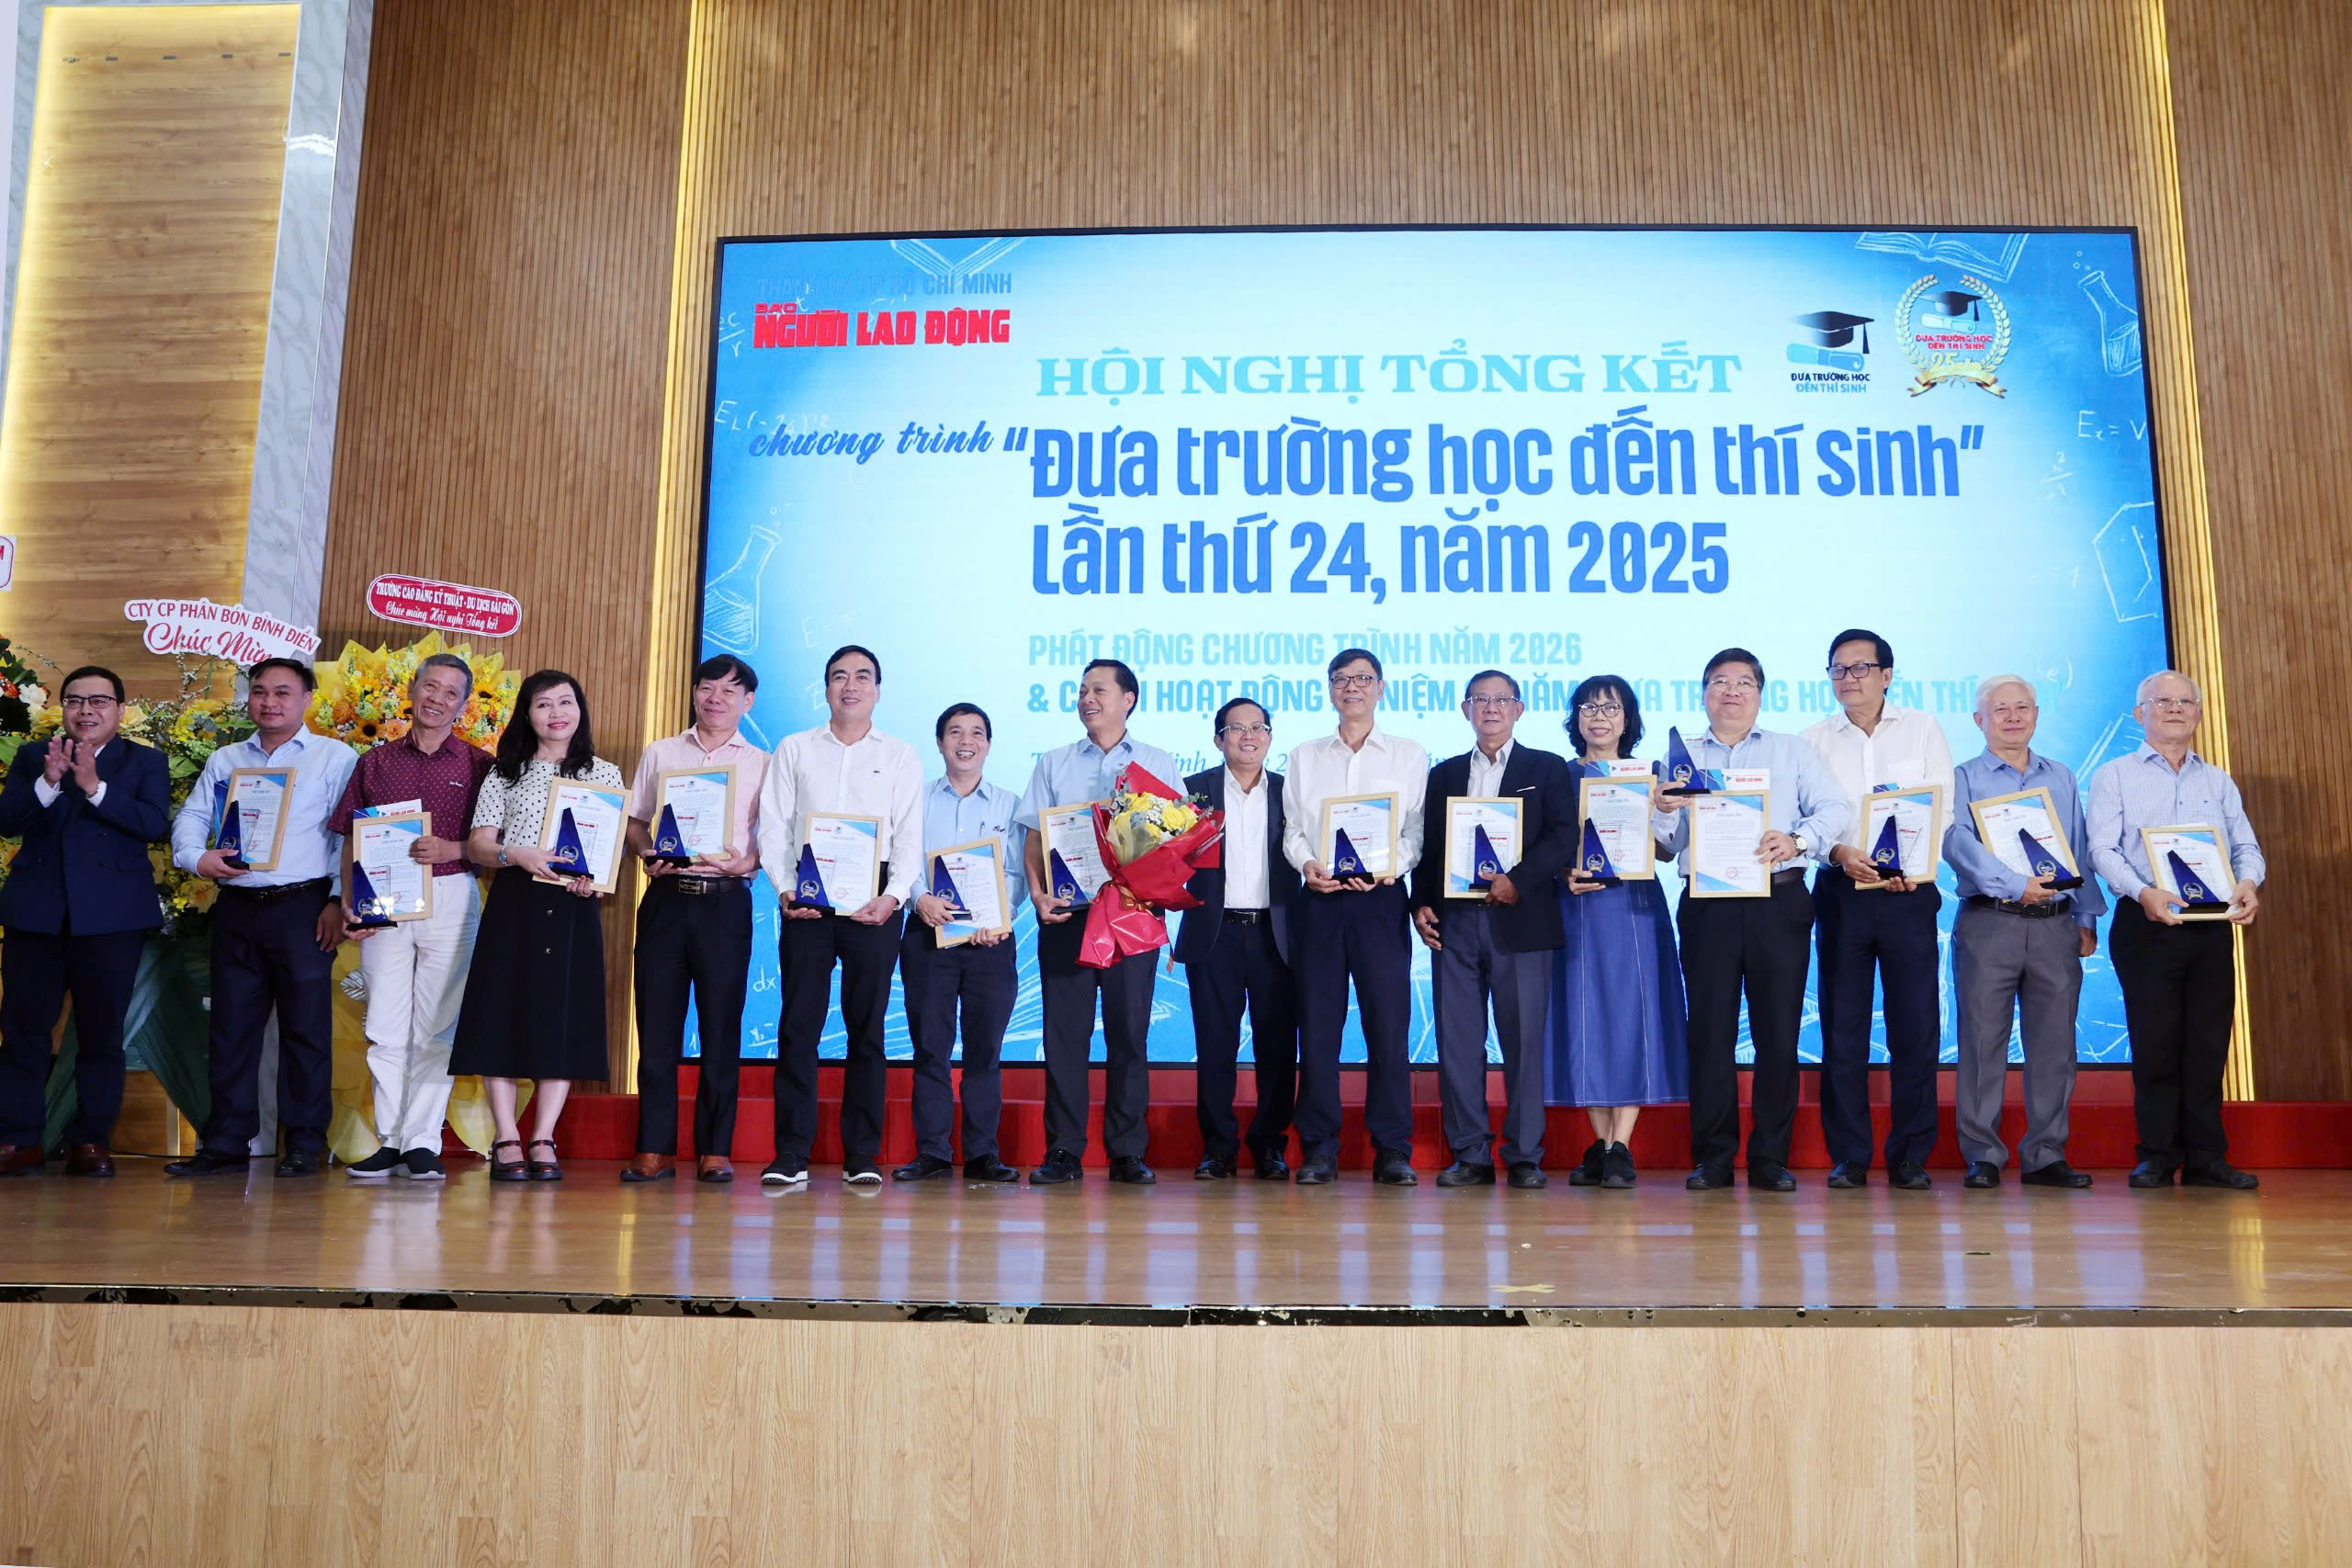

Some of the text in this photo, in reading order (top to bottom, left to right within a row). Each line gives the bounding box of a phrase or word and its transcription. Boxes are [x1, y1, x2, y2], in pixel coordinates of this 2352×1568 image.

[962, 273, 1012, 294] MINH
[855, 310, 917, 345] LAO
[923, 306, 1011, 346] ĐỘNG
[1035, 337, 1743, 407] HỘI NGHỊ TỔNG KẾT
[1791, 370, 1871, 384] ĐƯA TRƯỜNG HỌC
[1795, 380, 1867, 393] ĐẾN THÍ SINH
[748, 423, 885, 466] chương
[896, 420, 994, 454] trình
[1177, 415, 1414, 502] trường
[1428, 423, 1554, 513] học
[1569, 404, 1697, 496] đến
[1713, 423, 1804, 495] thí
[1032, 502, 1730, 604] Lần thứ 24, năm 2025
[376, 581, 401, 598] TRƯỜNG
[402, 586, 415, 598] CAO
[414, 582, 434, 604] ĐẲNG
[434, 588, 443, 604] KỸ
[444, 591, 464, 610] THUẬT
[467, 596, 476, 610] DU
[476, 598, 491, 614] LỊCH
[491, 598, 501, 614] SÀI
[502, 600, 514, 615] GÒN
[386, 600, 499, 631] Chúc mừng Hội nghị Tổng kết
[128, 598, 318, 652] CTY CP PHÂN BÓN BÌNH ĐIỀN
[147, 622, 212, 655] Chúc
[1028, 628, 1104, 666] PHÁT
[1112, 628, 1193, 672] ĐỘNG
[1203, 631, 1324, 666] CHƯƠNG
[1430, 626, 1501, 664] NĂM
[1509, 632, 1582, 665] 2026
[1027, 682, 1049, 713] &
[1156, 680, 1232, 719] HOẠT
[1241, 674, 1323, 717] ĐỘNG
[1379, 673, 1455, 719] NIỆM
